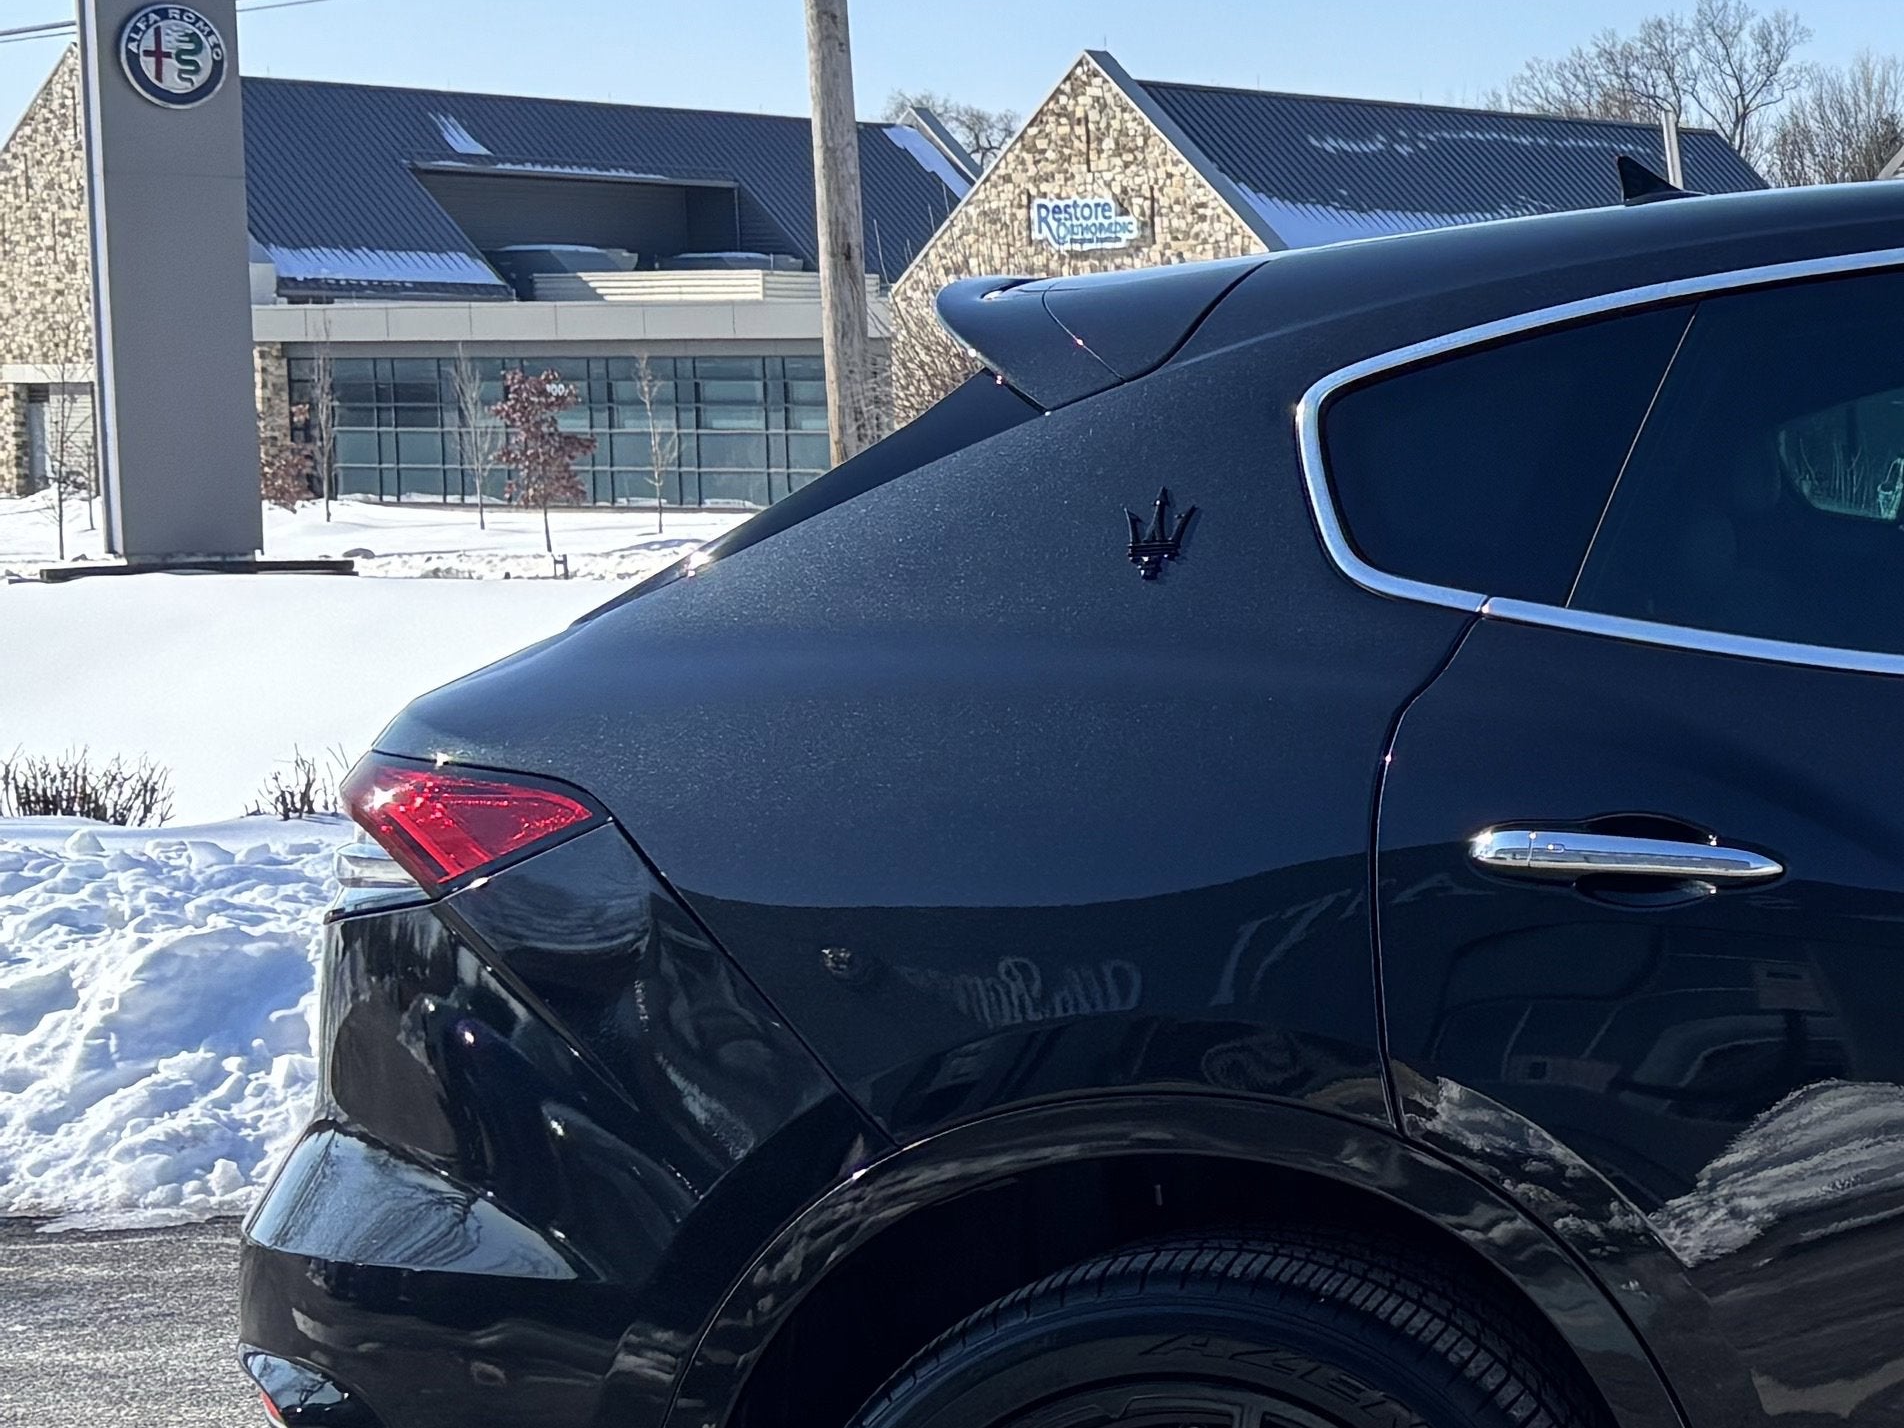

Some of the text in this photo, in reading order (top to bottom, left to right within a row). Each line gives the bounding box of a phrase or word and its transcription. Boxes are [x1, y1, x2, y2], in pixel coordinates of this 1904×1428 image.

[127, 9, 222, 61] ALFA ROMEO
[1037, 200, 1112, 245] Restore
